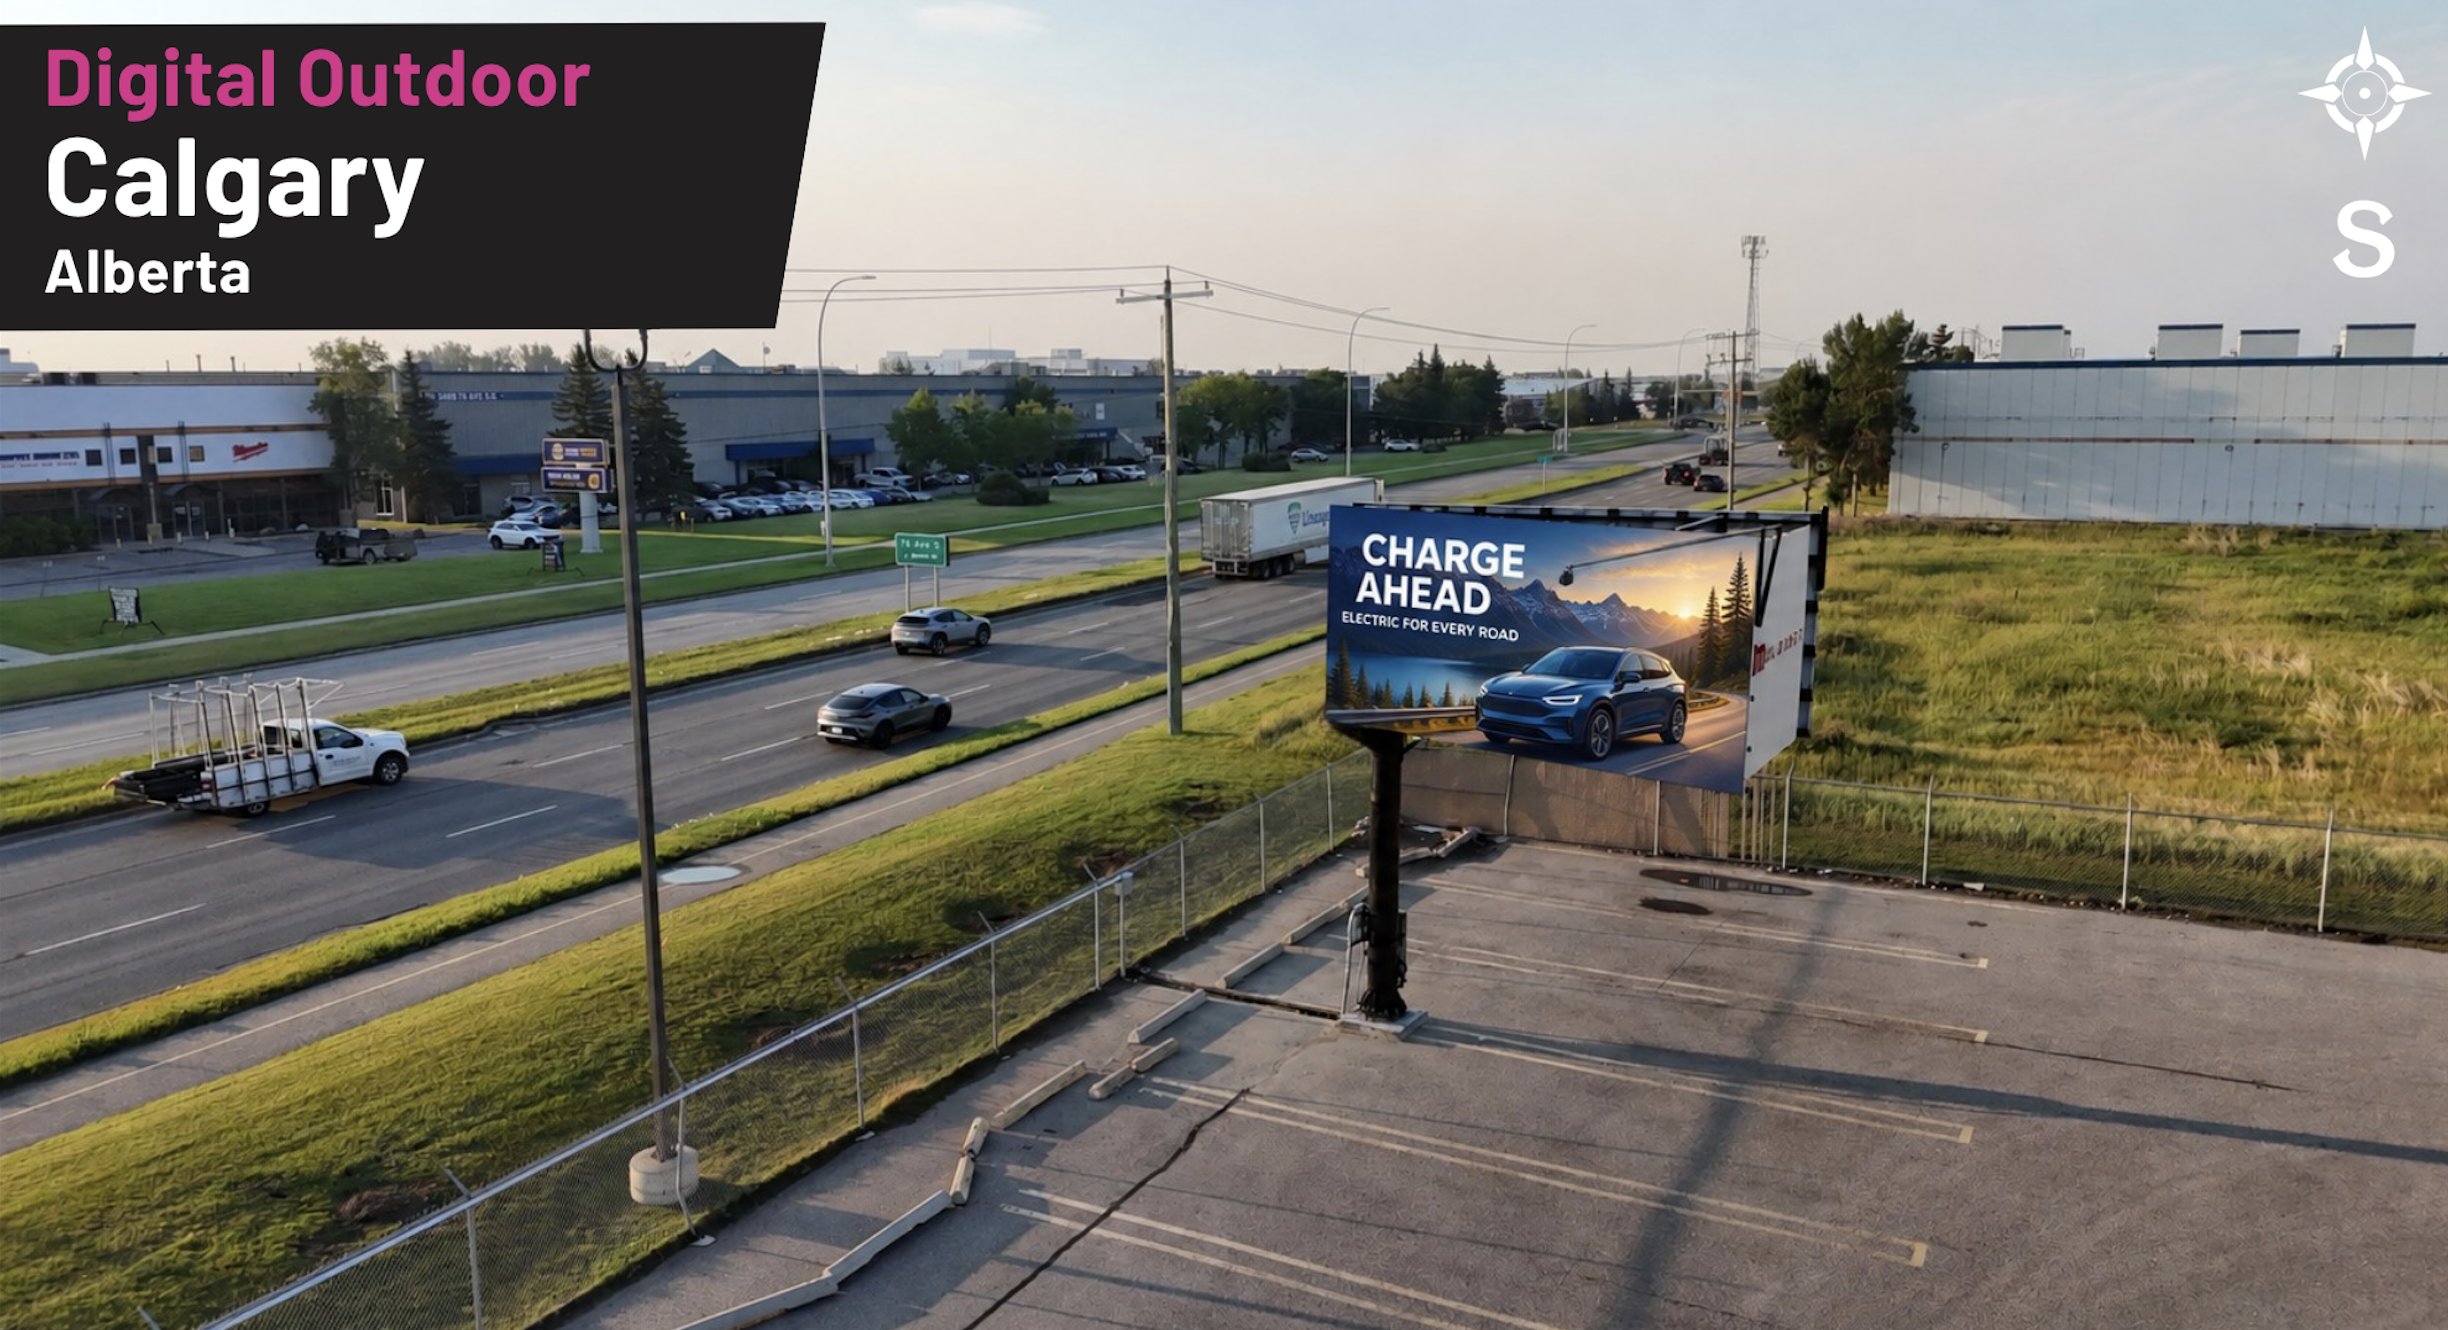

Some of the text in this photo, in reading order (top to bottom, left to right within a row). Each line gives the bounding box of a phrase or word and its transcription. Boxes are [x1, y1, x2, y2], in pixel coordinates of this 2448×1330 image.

[914, 540, 930, 549] Ave
[1362, 533, 1526, 579] CHARGE
[1355, 571, 1492, 615] AHEAD
[1341, 610, 1520, 643] ELECTRIC FOR EVERY ROAD
